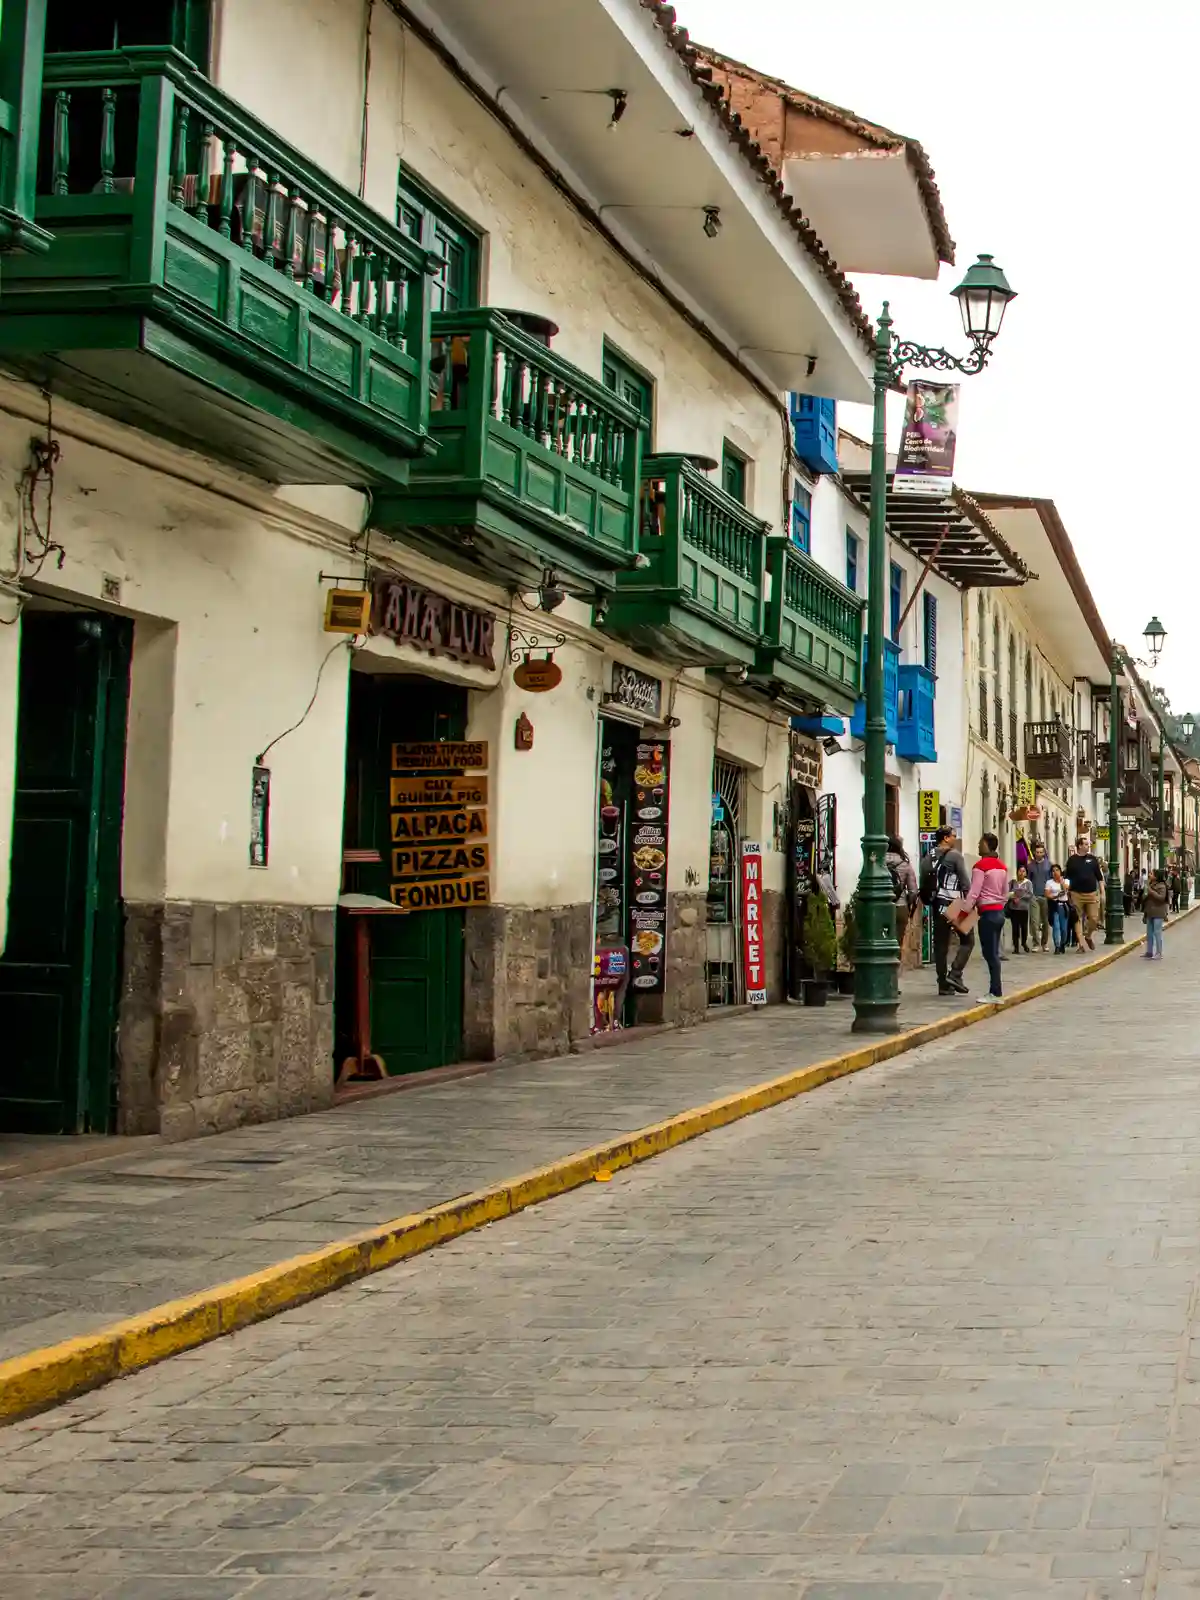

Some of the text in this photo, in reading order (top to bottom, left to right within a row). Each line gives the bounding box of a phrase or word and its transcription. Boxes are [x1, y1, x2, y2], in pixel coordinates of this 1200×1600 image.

[457, 790, 482, 802] PIG
[923, 791, 934, 827] MONEY
[395, 812, 484, 838] ALPACA
[396, 847, 486, 872] PIZZAS
[744, 843, 761, 853] VISA
[394, 880, 487, 907] FONDUE
[745, 862, 760, 984] MARKET
[749, 992, 765, 1001] VISA
